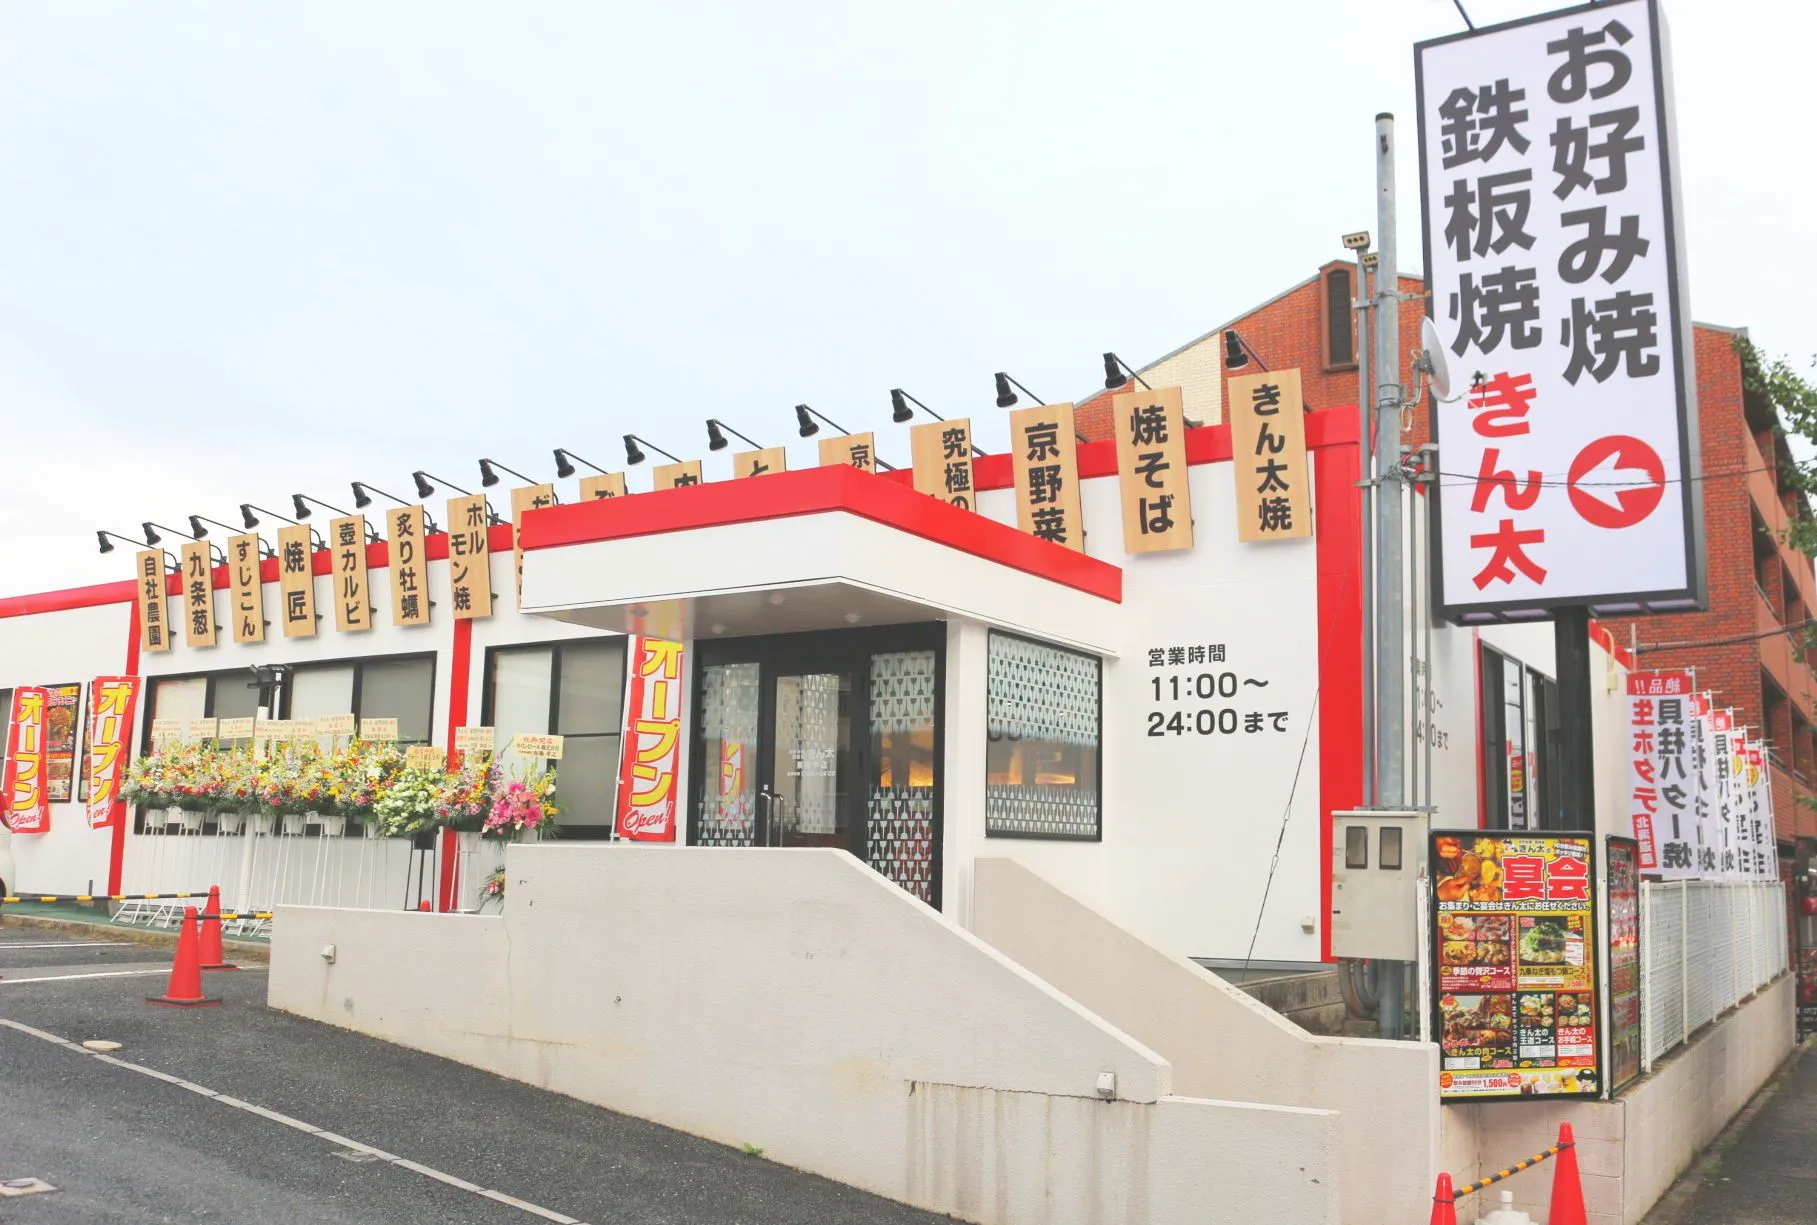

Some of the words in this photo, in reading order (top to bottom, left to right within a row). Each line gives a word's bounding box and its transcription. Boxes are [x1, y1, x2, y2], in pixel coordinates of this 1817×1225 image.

[1547, 19, 1660, 387] お好み焼
[1024, 421, 1068, 545] 京野菜
[1129, 404, 1175, 535] 焼そば
[1252, 383, 1293, 532] きん太焼
[144, 555, 162, 647] 自社農園
[189, 551, 208, 636] 九条葱
[236, 540, 256, 637] すじこん
[396, 512, 420, 620] 炙り牡蠣
[1147, 643, 1227, 667] 営業時間
[90, 683, 133, 807] オープン
[630, 639, 684, 808] オープン
[1146, 708, 1290, 737] 24:00まで
[624, 801, 673, 834] Open!
[1502, 854, 1589, 901] 宴会
